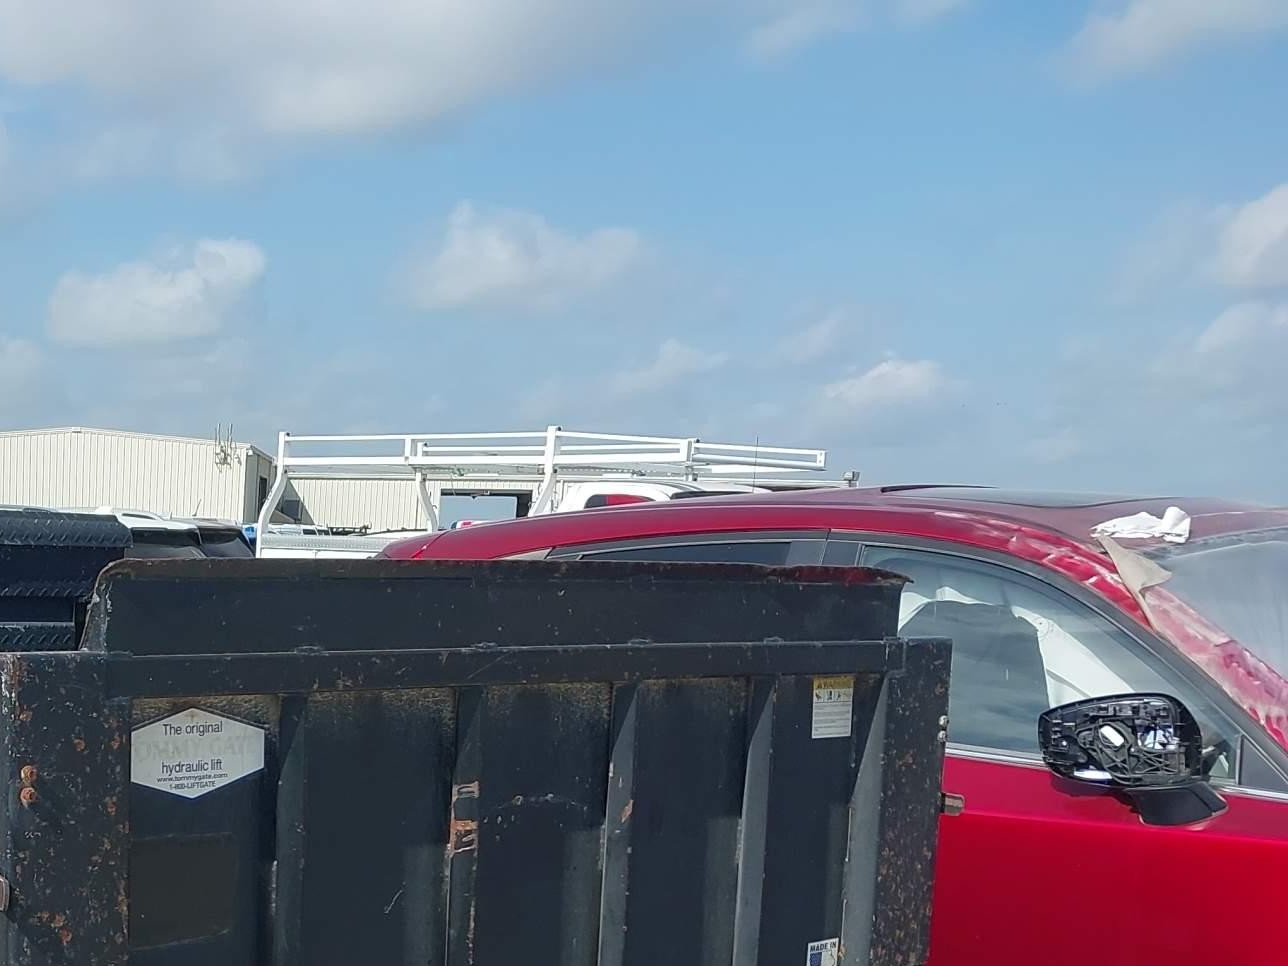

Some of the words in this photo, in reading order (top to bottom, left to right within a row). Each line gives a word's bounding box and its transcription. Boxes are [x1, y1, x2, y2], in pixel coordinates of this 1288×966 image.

[162, 723, 182, 736] The
[185, 720, 223, 736] original
[161, 759, 209, 776] hydraulic
[210, 758, 223, 771] lift
[810, 943, 829, 952] MADE
